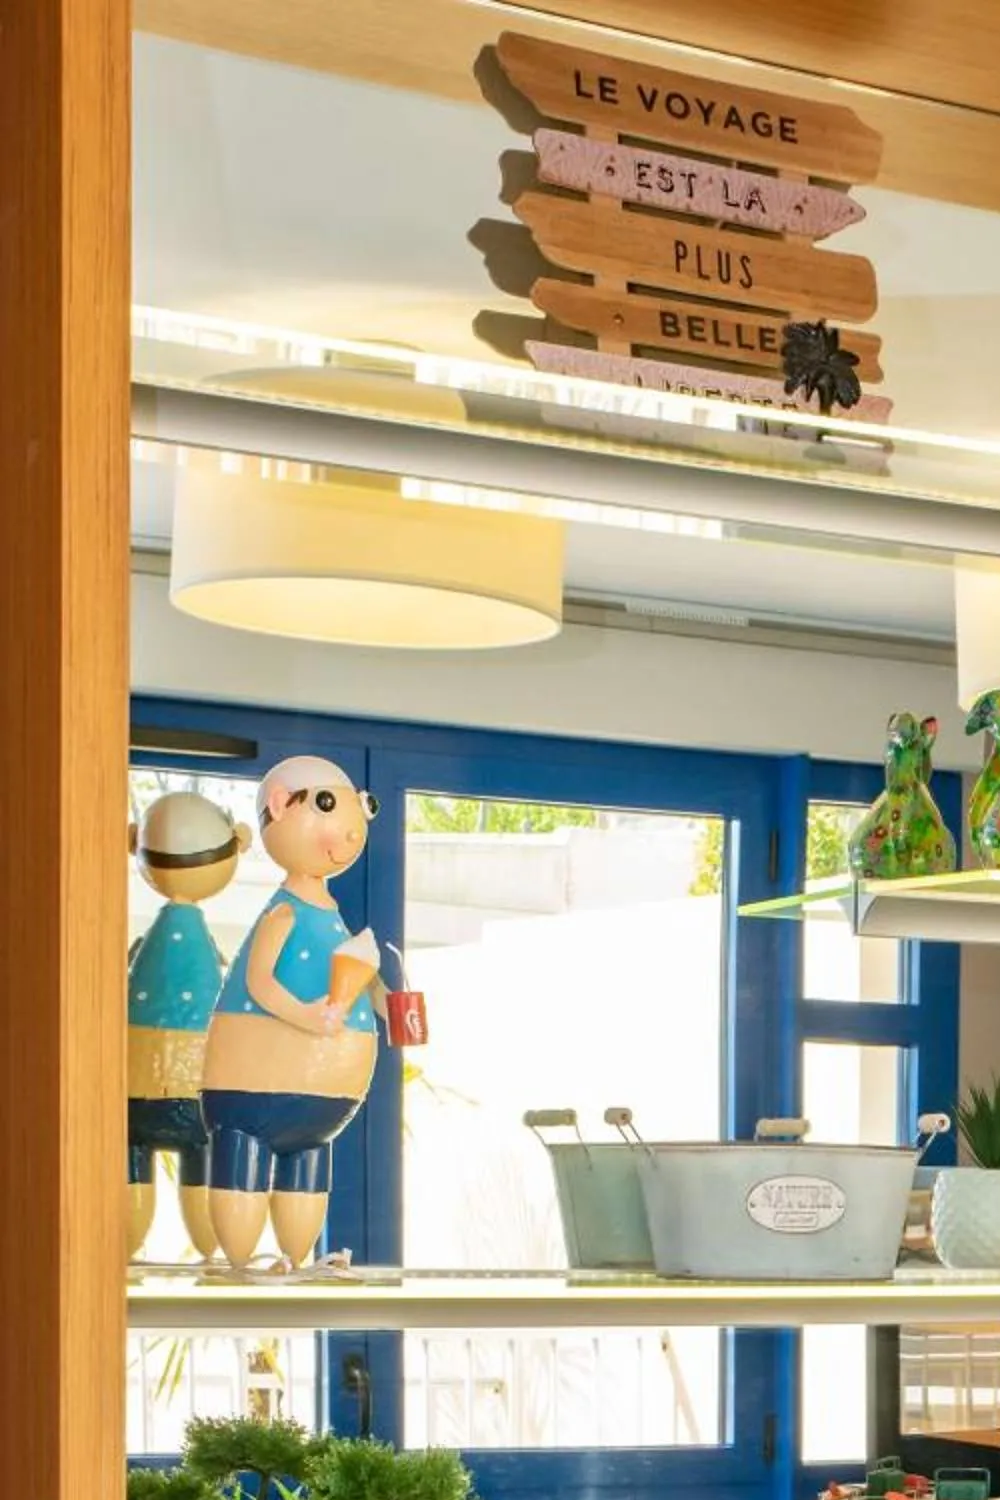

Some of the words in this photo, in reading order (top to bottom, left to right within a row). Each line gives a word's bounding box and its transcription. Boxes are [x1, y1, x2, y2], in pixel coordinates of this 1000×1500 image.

[574, 70, 620, 104] LE
[637, 84, 799, 144] VOYAGE
[634, 161, 697, 200] EST
[722, 182, 767, 214] LA
[674, 239, 754, 290] PLUS
[659, 310, 778, 354] BELLE
